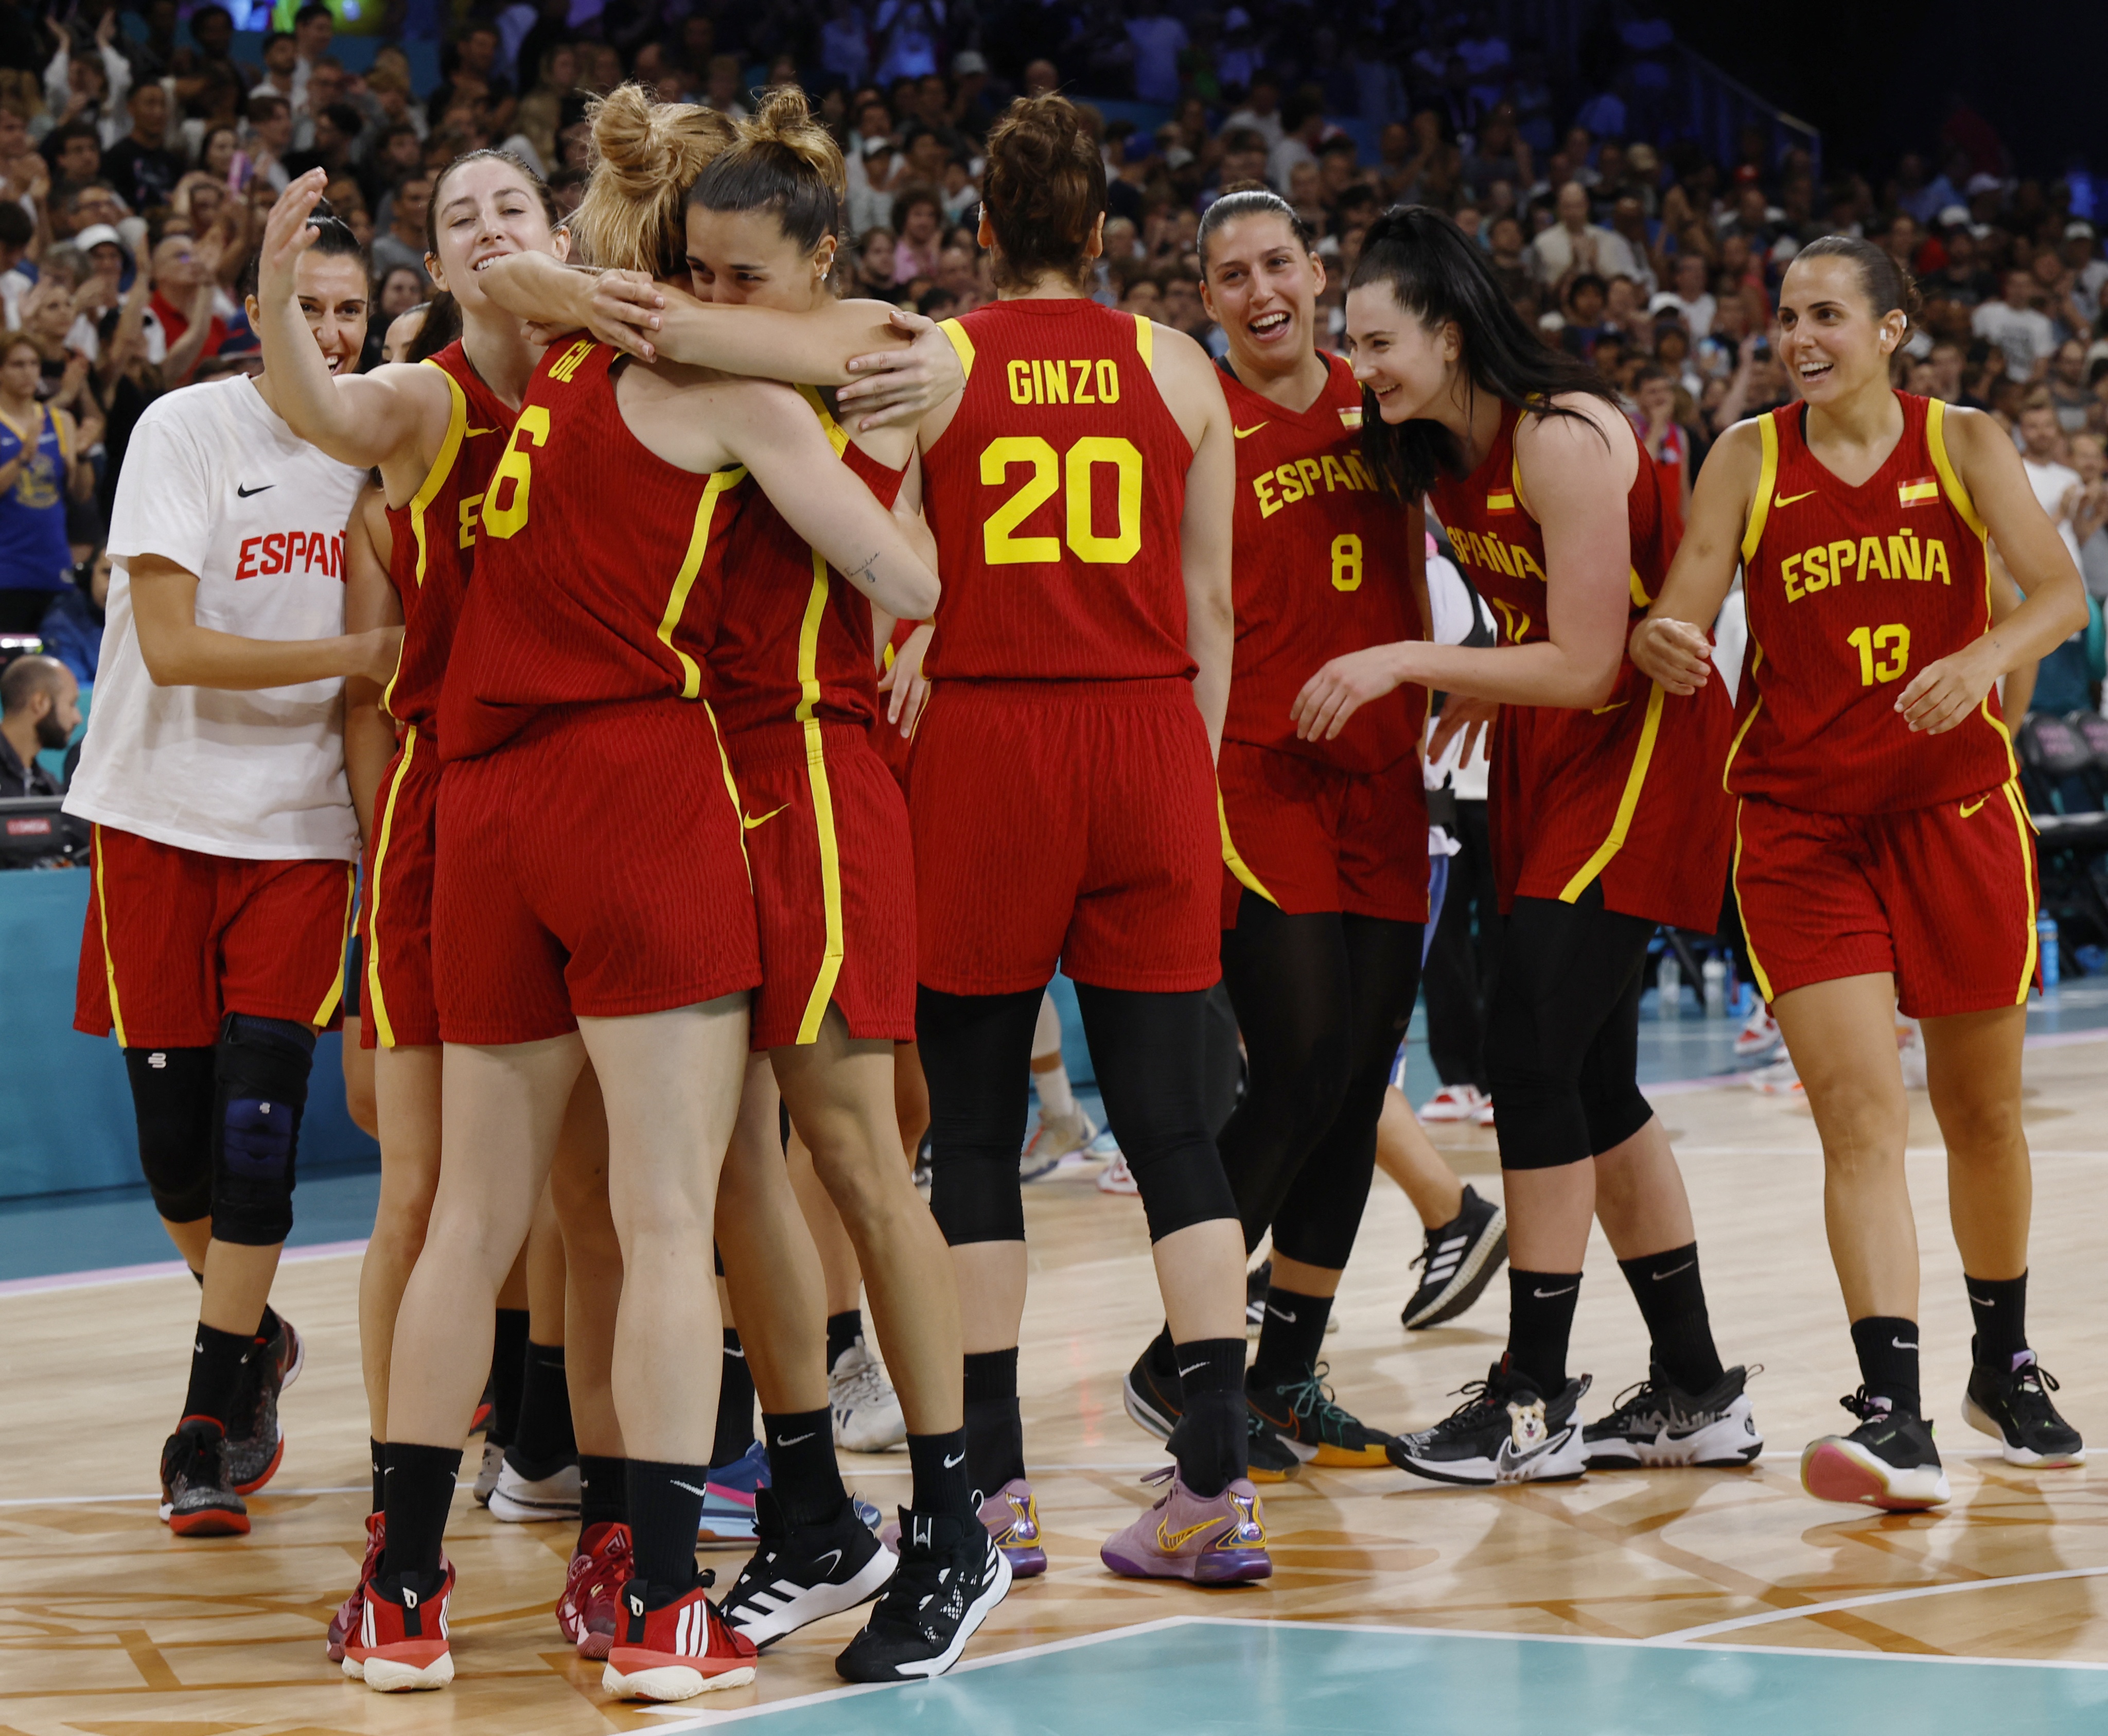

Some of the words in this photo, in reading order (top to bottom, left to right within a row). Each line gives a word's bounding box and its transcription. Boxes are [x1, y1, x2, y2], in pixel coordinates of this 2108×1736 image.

[548, 339, 596, 383] GIL
[1007, 359, 1120, 405] GINZO
[482, 404, 550, 539] 6
[980, 436, 1143, 565] 20
[1253, 449, 1379, 519] ESPAÑ
[235, 529, 346, 584] ESPAÑ
[1331, 533, 1363, 591] 8
[1446, 526, 1547, 582] SPAÑA
[1781, 528, 1951, 603] ESPAÑA
[1847, 623, 1910, 686] 13
